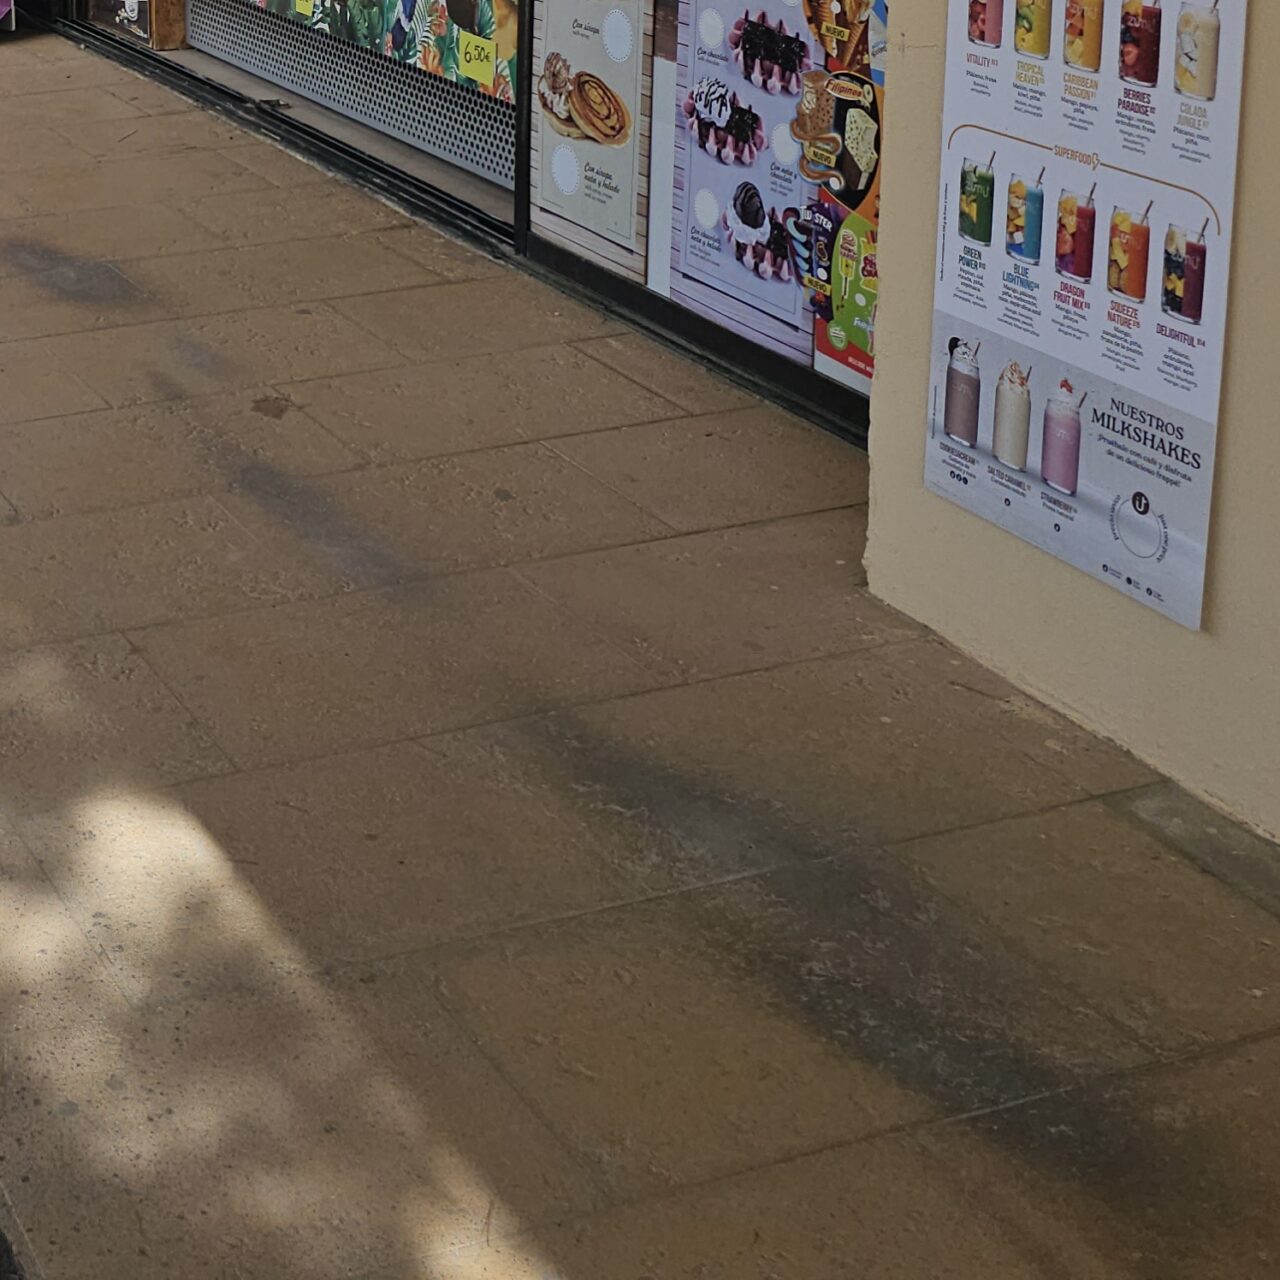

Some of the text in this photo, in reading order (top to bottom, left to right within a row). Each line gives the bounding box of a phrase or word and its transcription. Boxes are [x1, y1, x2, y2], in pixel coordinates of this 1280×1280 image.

[825, 25, 846, 39] NUEVO
[697, 47, 706, 57] Con
[966, 52, 991, 68] VITALITY
[827, 80, 862, 97] Filipinos
[1123, 87, 1151, 105] BERRIES
[1117, 98, 1150, 117] PARADISE
[812, 149, 832, 165] NUEVO
[1053, 144, 1093, 167] SUPERFOOD
[770, 161, 780, 173] Con
[963, 245, 982, 260] GREEN
[958, 254, 978, 271] POWER
[1013, 263, 1030, 279] BLUE
[807, 277, 827, 293] NUEVO
[1060, 280, 1086, 299] DRAGON
[1053, 290, 1084, 311] FRUIT MIX
[1110, 299, 1139, 320] SQUEEZE
[1107, 310, 1133, 330] NATURE
[1156, 322, 1197, 348] DELIGHTFUL
[1110, 397, 1184, 441] NUESTROS
[1091, 407, 1201, 470] MILKSHAKES
